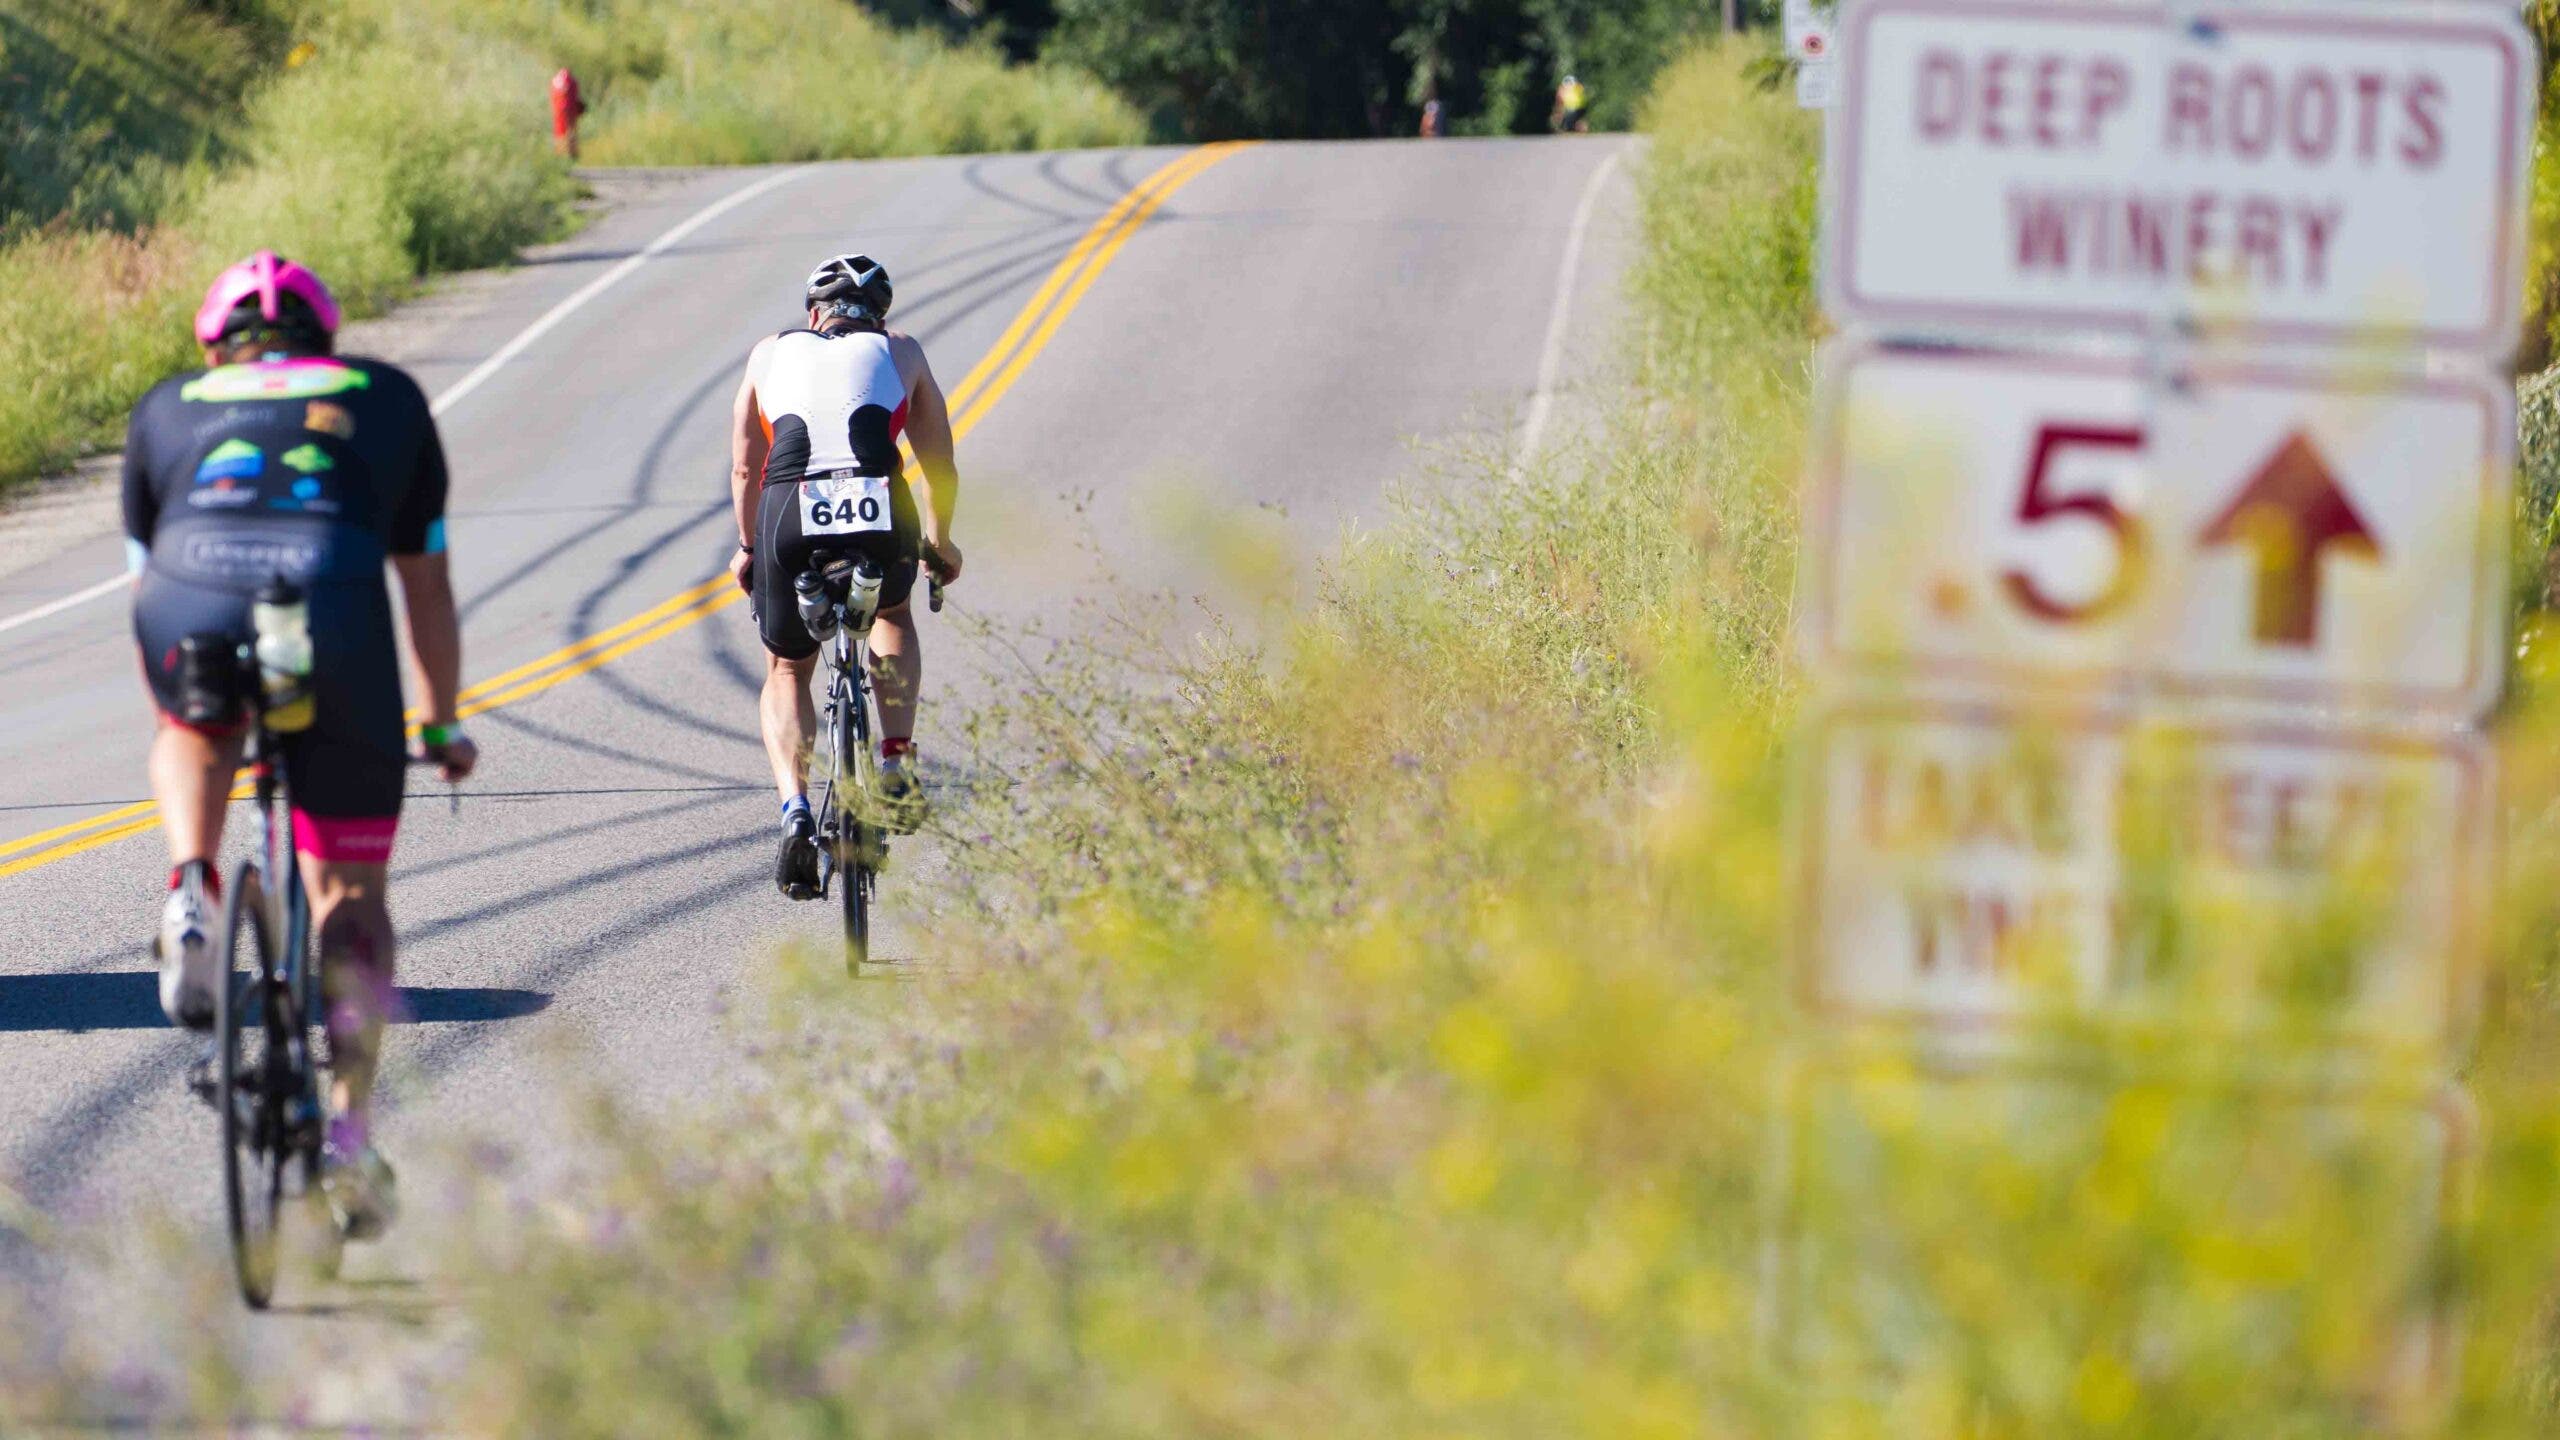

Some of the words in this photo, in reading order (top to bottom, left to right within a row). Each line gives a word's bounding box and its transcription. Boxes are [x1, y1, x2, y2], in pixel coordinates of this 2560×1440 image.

[1916, 50, 2131, 147] DEEP
[2166, 58, 2445, 168] ROOTS
[2007, 189, 2338, 286] WINERY
[811, 496, 880, 526] 640
